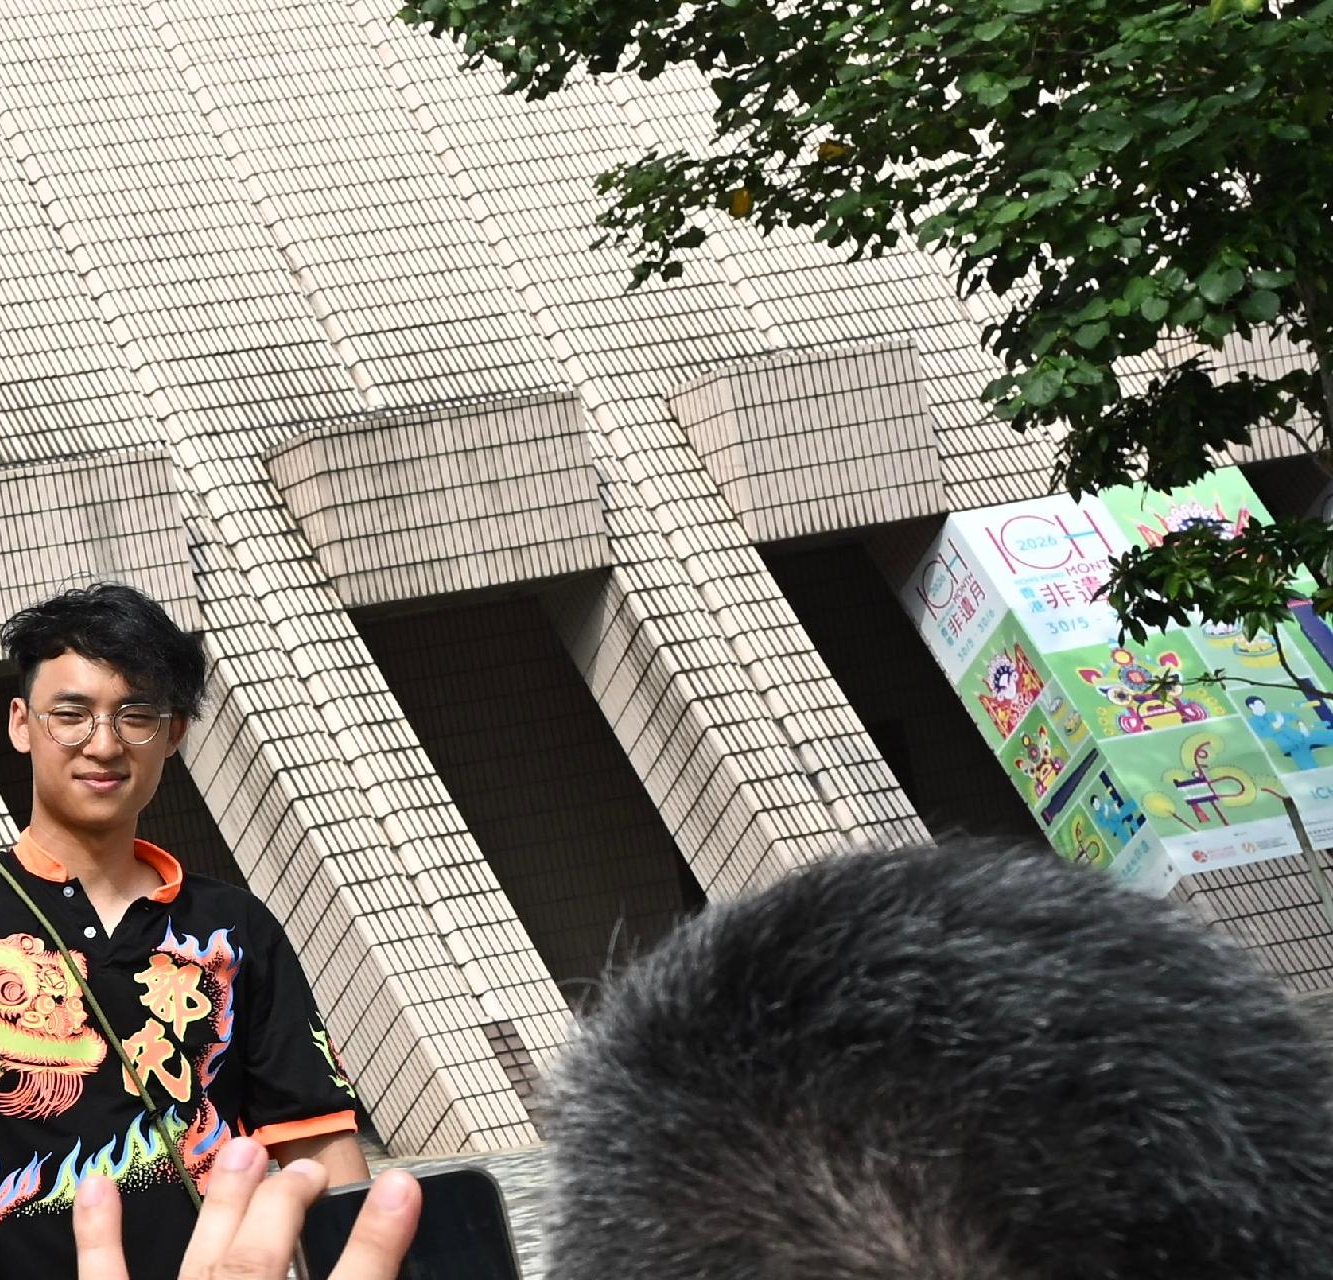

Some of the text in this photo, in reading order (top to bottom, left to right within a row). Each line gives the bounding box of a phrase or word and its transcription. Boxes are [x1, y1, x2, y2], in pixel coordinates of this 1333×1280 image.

[985, 510, 1113, 574] ICH
[1016, 535, 1058, 551] 2026
[1065, 559, 1110, 576] MONT
